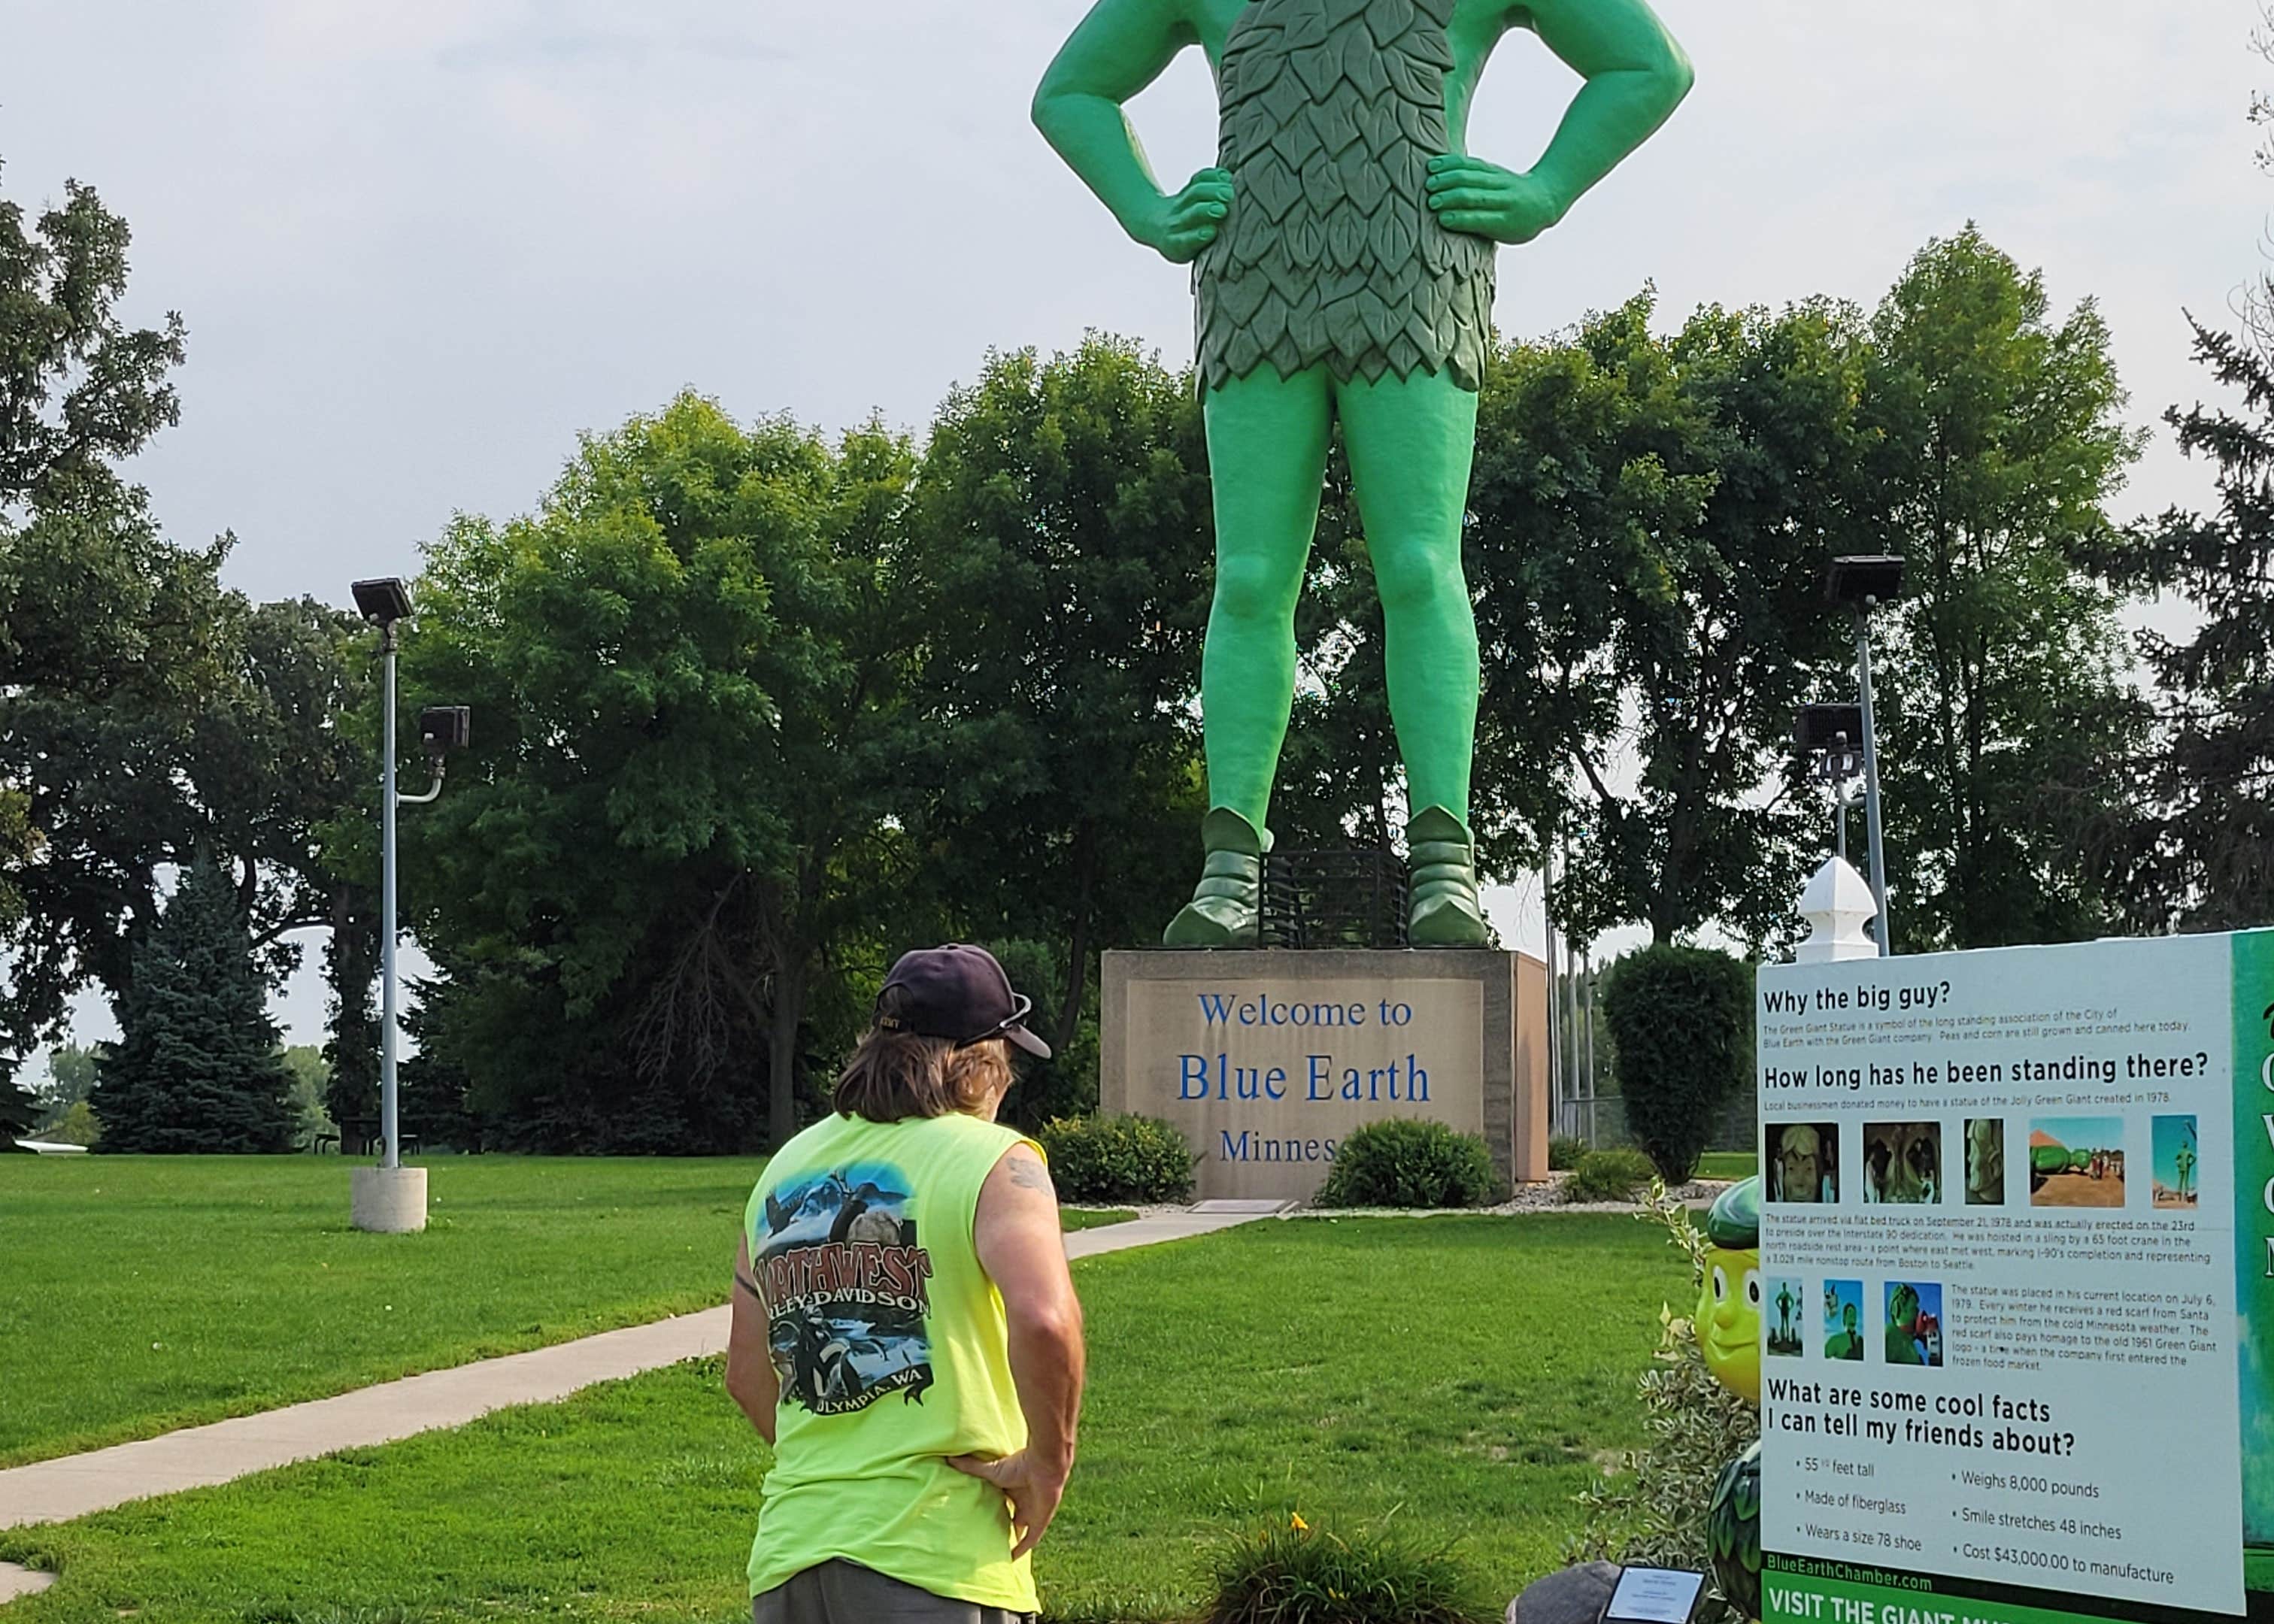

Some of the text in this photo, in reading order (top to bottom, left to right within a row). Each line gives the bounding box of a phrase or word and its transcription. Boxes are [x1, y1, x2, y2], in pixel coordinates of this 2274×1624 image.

[1197, 993, 1412, 1027] Welcome to
[1763, 980, 1951, 1017] Why the big guy?
[1178, 1054, 1431, 1102] Blue Earth
[1764, 1051, 2208, 1091] How long has he been standing there?
[1219, 1130, 1337, 1162] Minnes
[1951, 1283, 1968, 1294] The
[1969, 1286, 1998, 1295] statue
[2000, 1288, 2019, 1296] was
[2021, 1287, 2053, 1298] placed
[2066, 1289, 2081, 1299] his
[2083, 1290, 2119, 1301] current
[2121, 1291, 2163, 1303] location
[2164, 1295, 2179, 1304] on
[2181, 1294, 2203, 1307] July
[2205, 1294, 2216, 1305] 6,
[1978, 1299, 2005, 1312] Every
[2007, 1302, 2037, 1312] winter
[2039, 1303, 2051, 1313] he
[2054, 1304, 2094, 1315] receives
[2097, 1307, 2103, 1315] a
[2105, 1306, 2122, 1316] red
[2124, 1306, 2150, 1318] scarf
[2152, 1307, 2177, 1319] from
[2179, 1308, 2209, 1320] Santa
[1951, 1313, 1961, 1323] to
[1963, 1314, 1997, 1326] protect
[1999, 1315, 2017, 1324] him
[2018, 1316, 2042, 1327] from
[2043, 1318, 2060, 1328] the
[2061, 1319, 2084, 1329] cold
[2085, 1320, 2136, 1332] Minnesota
[2189, 1324, 2209, 1336] The
[1951, 1328, 1967, 1338] red
[1969, 1328, 1991, 1339] scarf
[1994, 1331, 2013, 1341] also
[2015, 1332, 2037, 1344] pays
[2039, 1332, 2078, 1346] homage
[2080, 1335, 2091, 1345] to
[2094, 1336, 2110, 1346] the
[2112, 1336, 2130, 1347] old
[2154, 1338, 2186, 1350] Green
[2188, 1339, 2217, 1352] Giant
[890, 1368, 924, 1386] WA
[1951, 1356, 1981, 1367] frozen
[1983, 1357, 2005, 1368] food
[1767, 1377, 2050, 1423] What are some cool facts
[1768, 1407, 2075, 1456] I can tell my friends about?
[1804, 1456, 1818, 1471] 55
[1832, 1459, 1854, 1474] feet
[1857, 1462, 1875, 1476] tall
[1960, 1470, 2100, 1498] Weighs 8,000 pounds
[1804, 1489, 1906, 1515] Made of fiberglass
[1805, 1523, 1921, 1550] Wears a size 78 shoe
[1962, 1507, 2121, 1540] Smile stretches 48 inches
[1767, 1554, 1933, 1592] BlueEarthChamber.com
[1962, 1542, 2174, 1584] Cost $43,000.00 to manufacture
[1769, 1587, 1824, 1619] VISIT
[1830, 1596, 1875, 1624] THE
